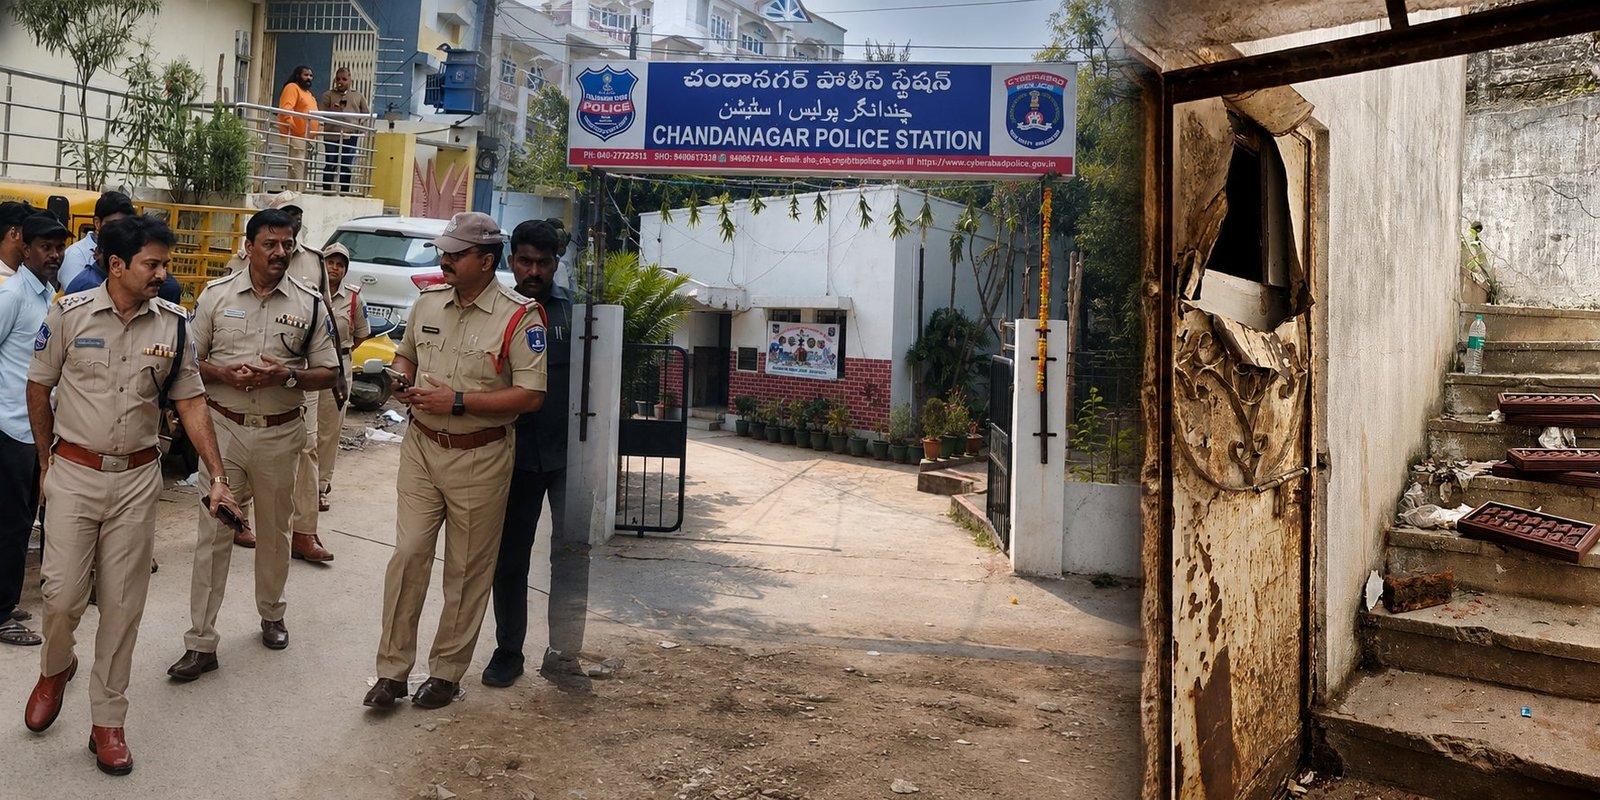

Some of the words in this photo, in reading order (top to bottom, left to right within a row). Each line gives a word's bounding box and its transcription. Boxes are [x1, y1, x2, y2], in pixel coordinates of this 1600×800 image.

[683, 68, 810, 89] చందానగర్
[583, 101, 630, 113] POLICE
[652, 125, 809, 148] CHANDANAGAR
[816, 127, 889, 149] POLICE
[895, 129, 982, 151] STATION
[654, 152, 672, 161] SHO:
